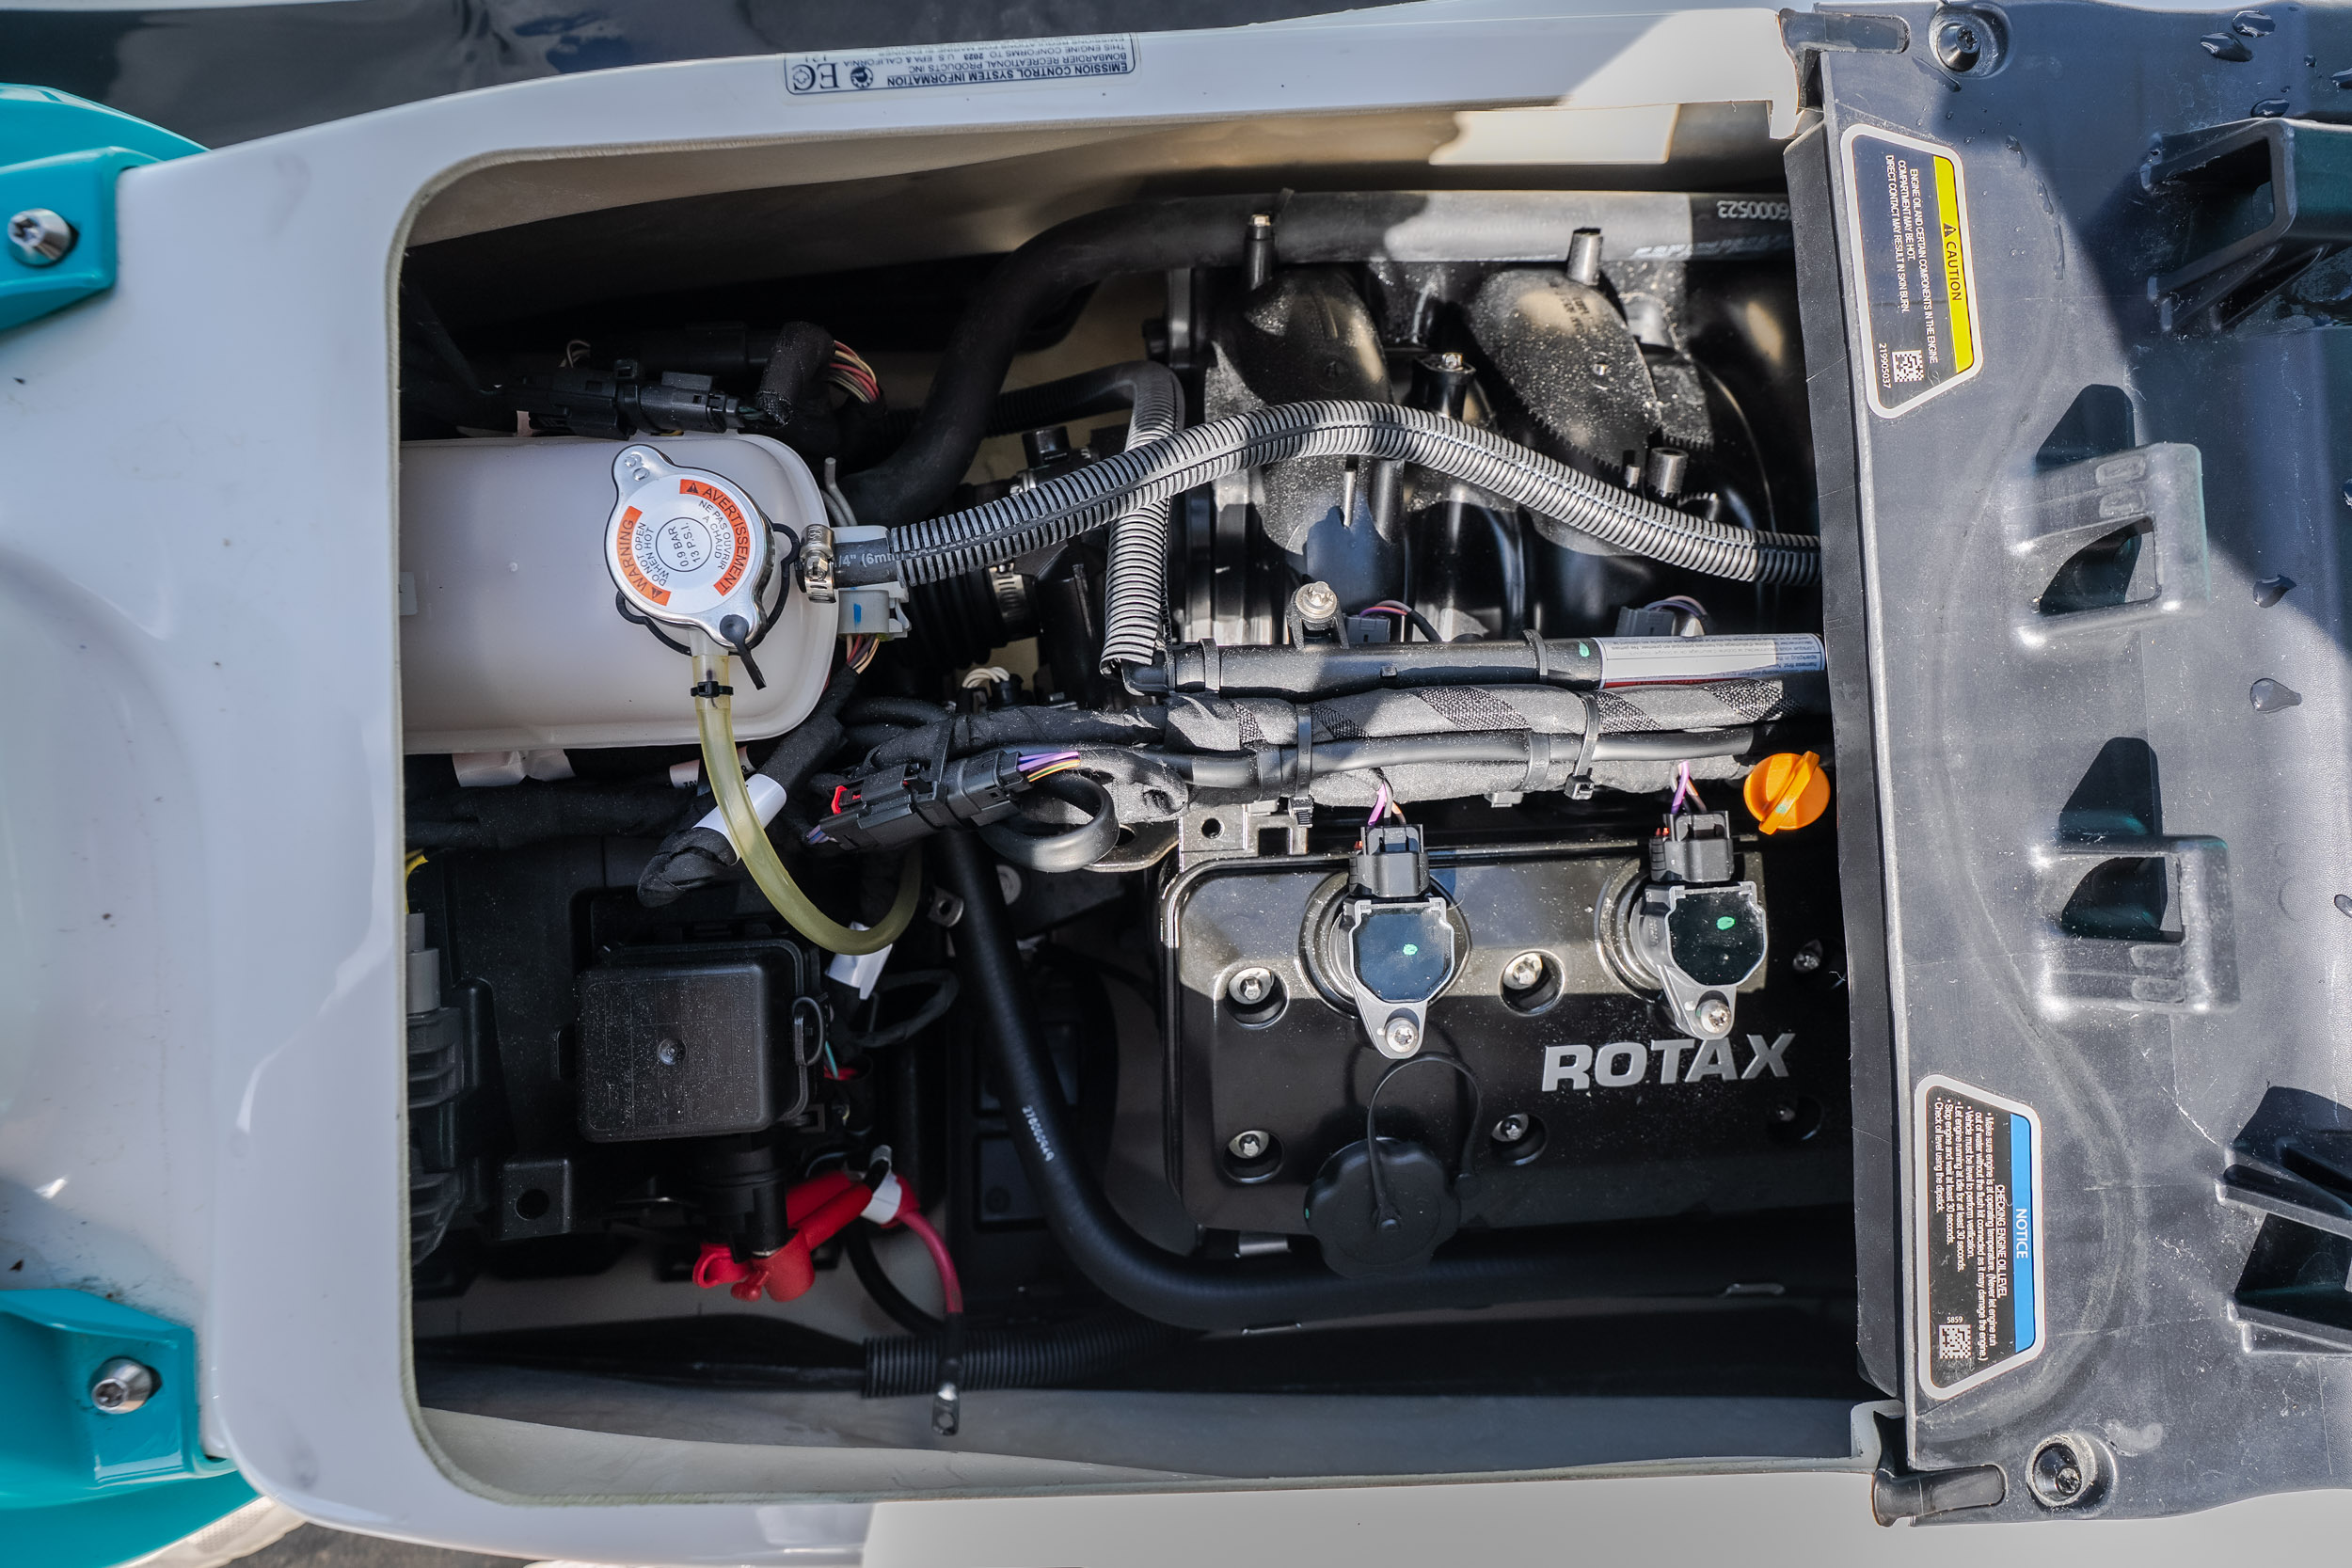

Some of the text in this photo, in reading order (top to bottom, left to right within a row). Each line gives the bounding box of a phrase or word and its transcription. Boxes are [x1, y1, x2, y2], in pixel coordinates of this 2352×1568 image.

[844, 57, 902, 67] CALIFORNIA
[929, 62, 982, 72] PRODUCTS
[984, 57, 1059, 68] RECREATIONAL
[1062, 53, 1126, 63] BOMBARDIER
[888, 63, 1127, 86] EMISSION CONTROL SYSTEM INFORMATION
[1910, 169, 1920, 197] ENGINE
[1898, 160, 1915, 261] COMPARTMENT MAY BE HOT.
[1913, 198, 1921, 210] OIL
[1914, 210, 1923, 225] AND
[1885, 155, 1909, 313] DIRECT CONTACT MAY RESULT IN SKIN BURN.
[1915, 227, 1926, 258] CERTAIN
[1947, 241, 1962, 301] CAUTION
[1919, 260, 1932, 309] COMPONENTS
[1926, 320, 1934, 335] THE
[1928, 336, 1938, 364] ENGINE
[1879, 342, 1891, 388] 219905037
[699, 499, 732, 570] NE PAS OUVRIR
[703, 487, 749, 593] AVERTISSEMENT
[710, 523, 723, 559] CHAUD
[619, 519, 647, 592] WARNING
[635, 522, 667, 586] DO NOT OPEN
[644, 527, 670, 579] WHEN HOT
[668, 527, 690, 567] 0.9 BAR
[693, 550, 700, 562] 13
[834, 554, 856, 567] /4"
[1542, 1033, 1795, 1091] ROTAX
[1935, 1101, 1944, 1124] Check
[1944, 1104, 1953, 1120] Stop
[1955, 1106, 1963, 1117] Let
[1965, 1111, 1974, 1135] Vehicle
[1935, 1125, 1944, 1133] oil
[1944, 1121, 1953, 1145] engine
[1953, 1118, 1963, 1142] engine
[1985, 1117, 1994, 1136] Make
[1935, 1134, 1944, 1151] level
[1946, 1147, 1954, 1160] and
[1933, 1152, 1944, 1171] using
[1946, 1161, 1954, 1176] wait
[1954, 1144, 1963, 1169] running
[1966, 1155, 1974, 1164] be
[1976, 1153, 1984, 1178] without
[1984, 1154, 1994, 1178] engine
[1946, 1184, 1954, 1202] least
[1956, 1179, 1964, 1191] idle
[1976, 1179, 1984, 1191] the
[1934, 1185, 1945, 1212] dipstick.
[1947, 1203, 1954, 1212] 30
[1956, 1193, 1964, 1203] for
[1964, 1191, 1975, 1218] perform
[1977, 1192, 1985, 1208] flush
[1977, 1210, 1986, 1218] kit
[1985, 1195, 1995, 1227] operating
[1947, 1213, 1955, 1244] seconds.
[1957, 1229, 1965, 1239] 30
[1966, 1219, 1976, 1259] verification.
[1977, 1219, 1986, 1255] connected
[2016, 1209, 2028, 1259] NOTICE
[1985, 1228, 1995, 1272] temperature.
[1996, 1185, 2007, 1298] CHECKING ENGINE OIL LEVEL
[1957, 1241, 1965, 1272] seconds.
[1978, 1257, 1985, 1265] as
[1976, 1272, 1985, 1288] may
[1986, 1274, 1996, 1298] (Never
[1977, 1290, 1986, 1318] damage
[1988, 1299, 1996, 1307] let
[1979, 1319, 1987, 1331] the
[1987, 1308, 1997, 1333] engine
[1978, 1332, 1988, 1361] engine.)
